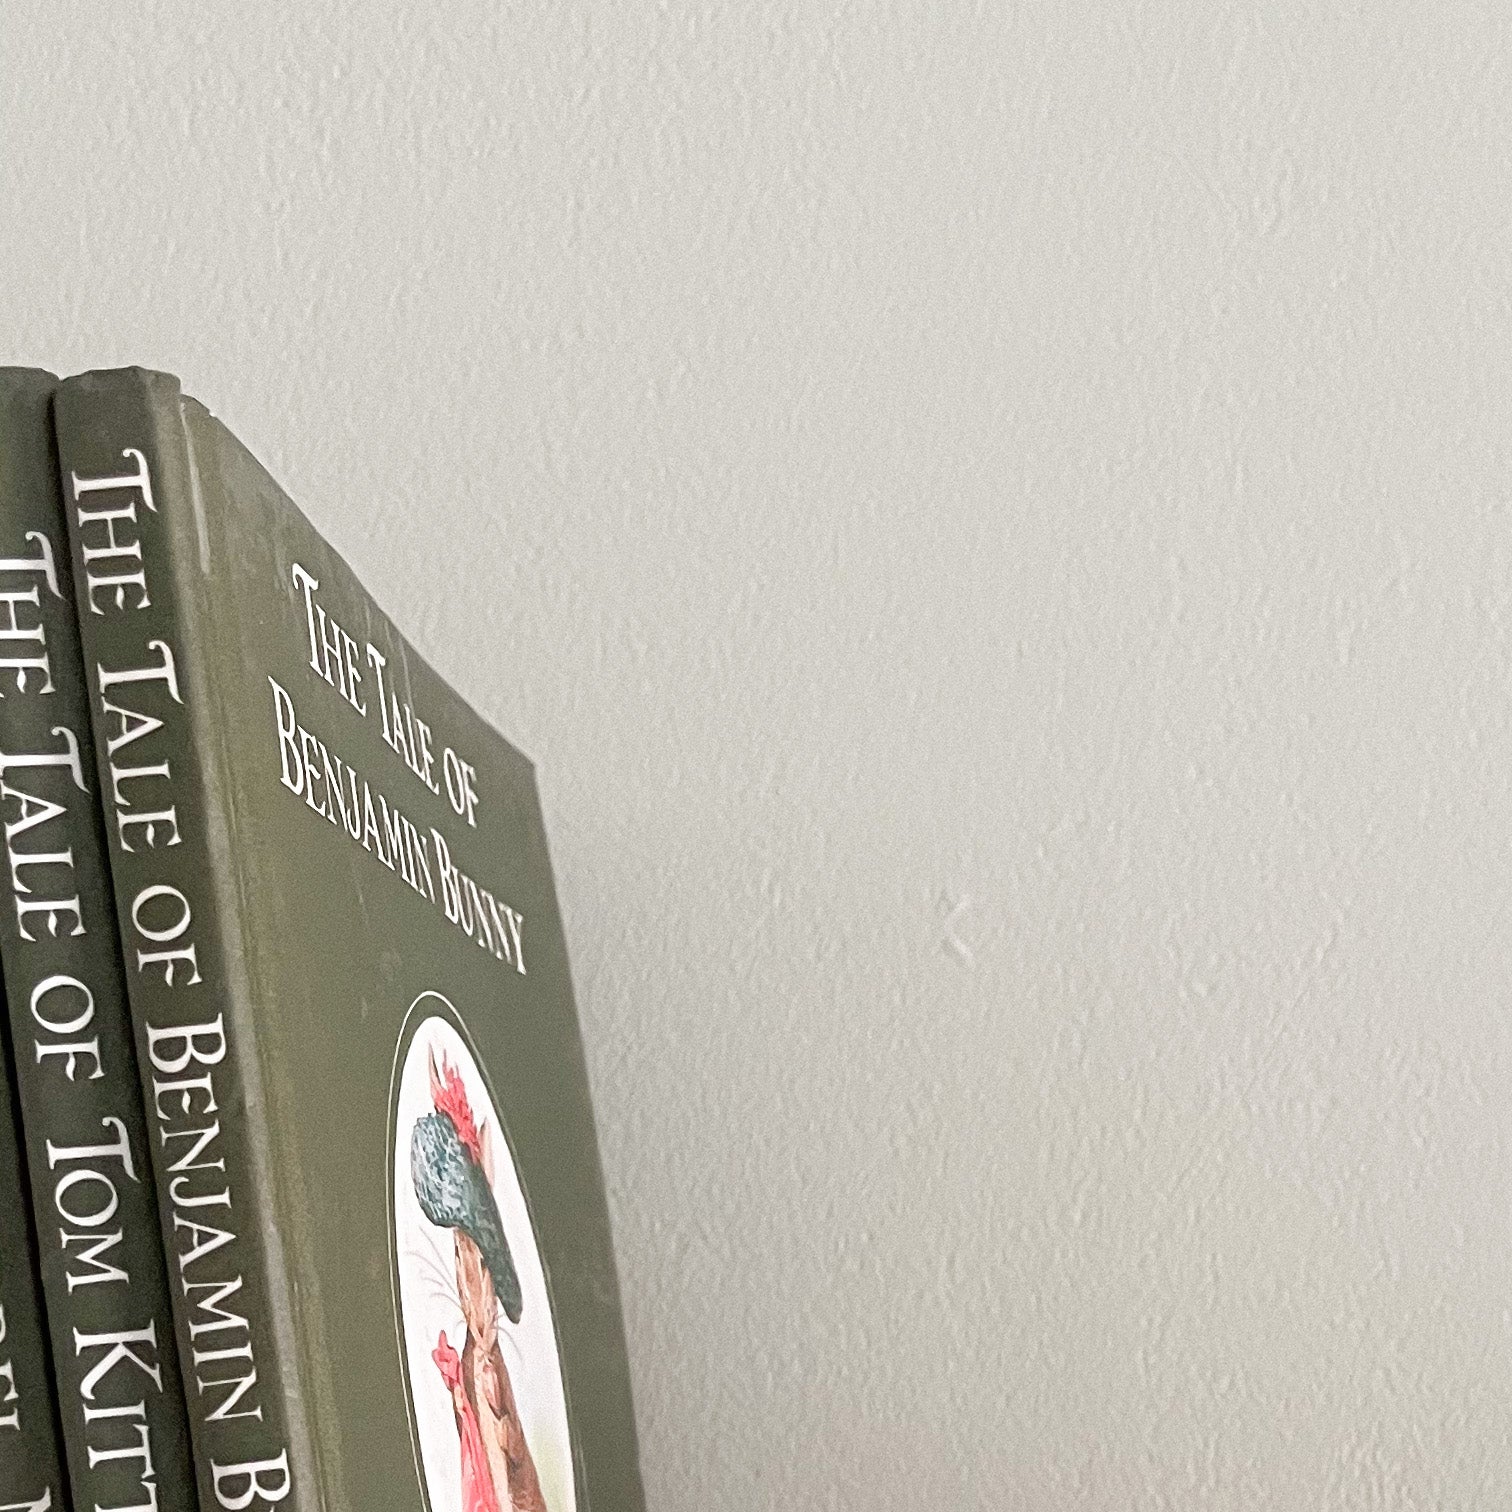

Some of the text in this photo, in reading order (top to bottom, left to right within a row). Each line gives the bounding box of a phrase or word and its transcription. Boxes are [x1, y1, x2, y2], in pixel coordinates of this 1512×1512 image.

[0, 531, 65, 698] THE
[72, 448, 157, 615] THE
[97, 640, 183, 853] TALE
[291, 562, 479, 829] THE TALE OF
[0, 727, 90, 940] TALE
[268, 675, 527, 977] BENJAMIN BUNNY
[31, 975, 103, 1082] OF
[131, 884, 202, 988] OF
[46, 1117, 139, 1293] TOM
[145, 1012, 263, 1422] BENJAMIN
